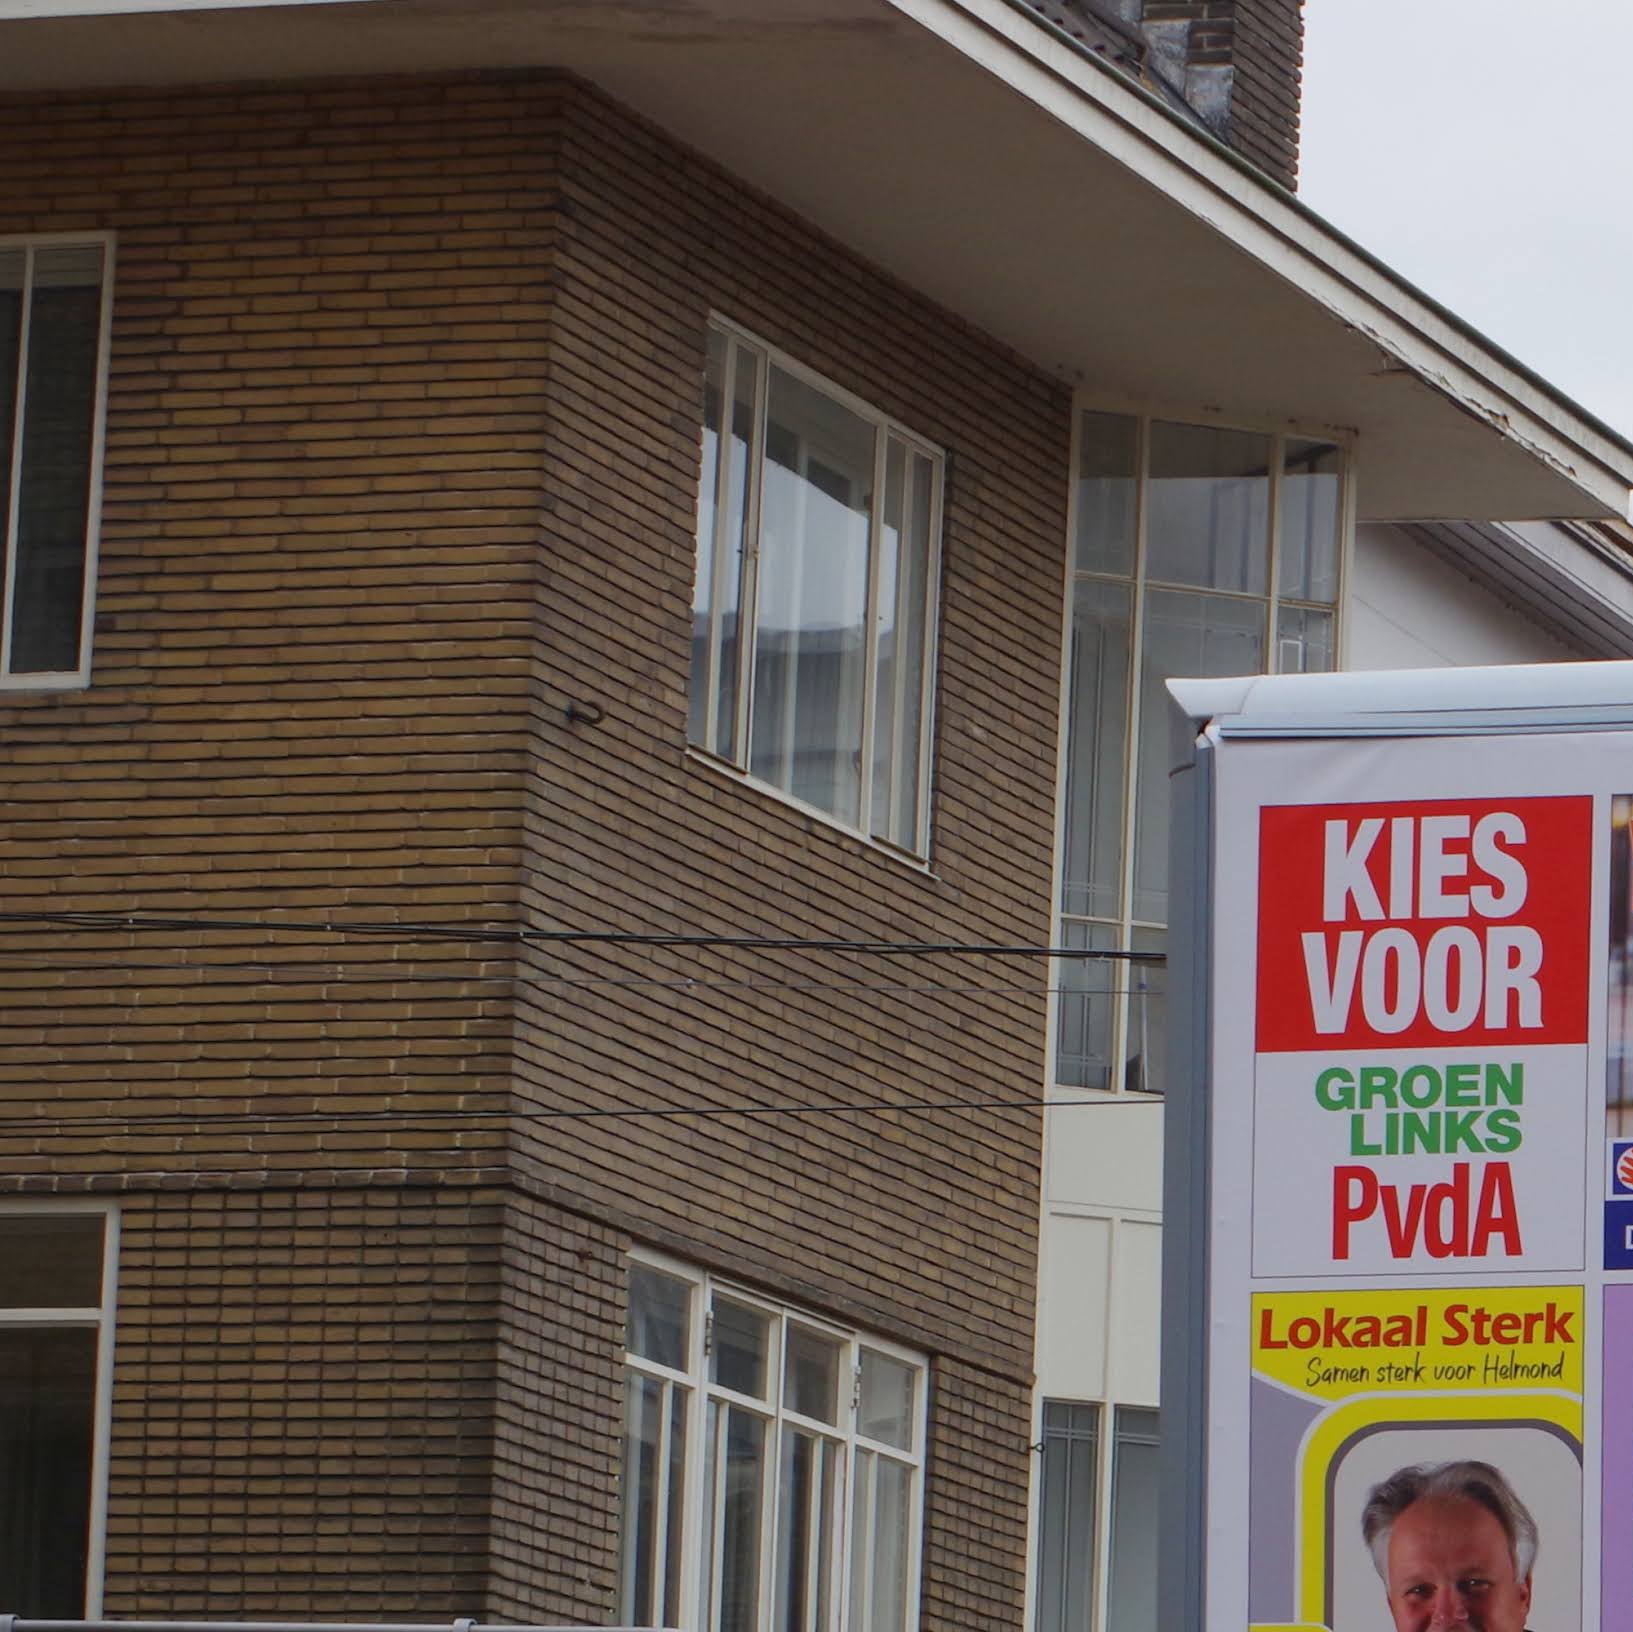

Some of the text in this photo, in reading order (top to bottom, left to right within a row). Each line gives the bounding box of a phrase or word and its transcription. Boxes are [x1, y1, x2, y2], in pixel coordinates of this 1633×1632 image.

[1322, 812, 1528, 922] KIES
[1301, 925, 1544, 1035] VOOR
[1315, 1063, 1525, 1112] GROEN
[1350, 1110, 1523, 1156] LINKS
[1332, 1161, 1523, 1260] PvdA
[1259, 1303, 1575, 1351] Lokaal Sterk
[1306, 1353, 1565, 1389] Samen sterk voor Helmond
